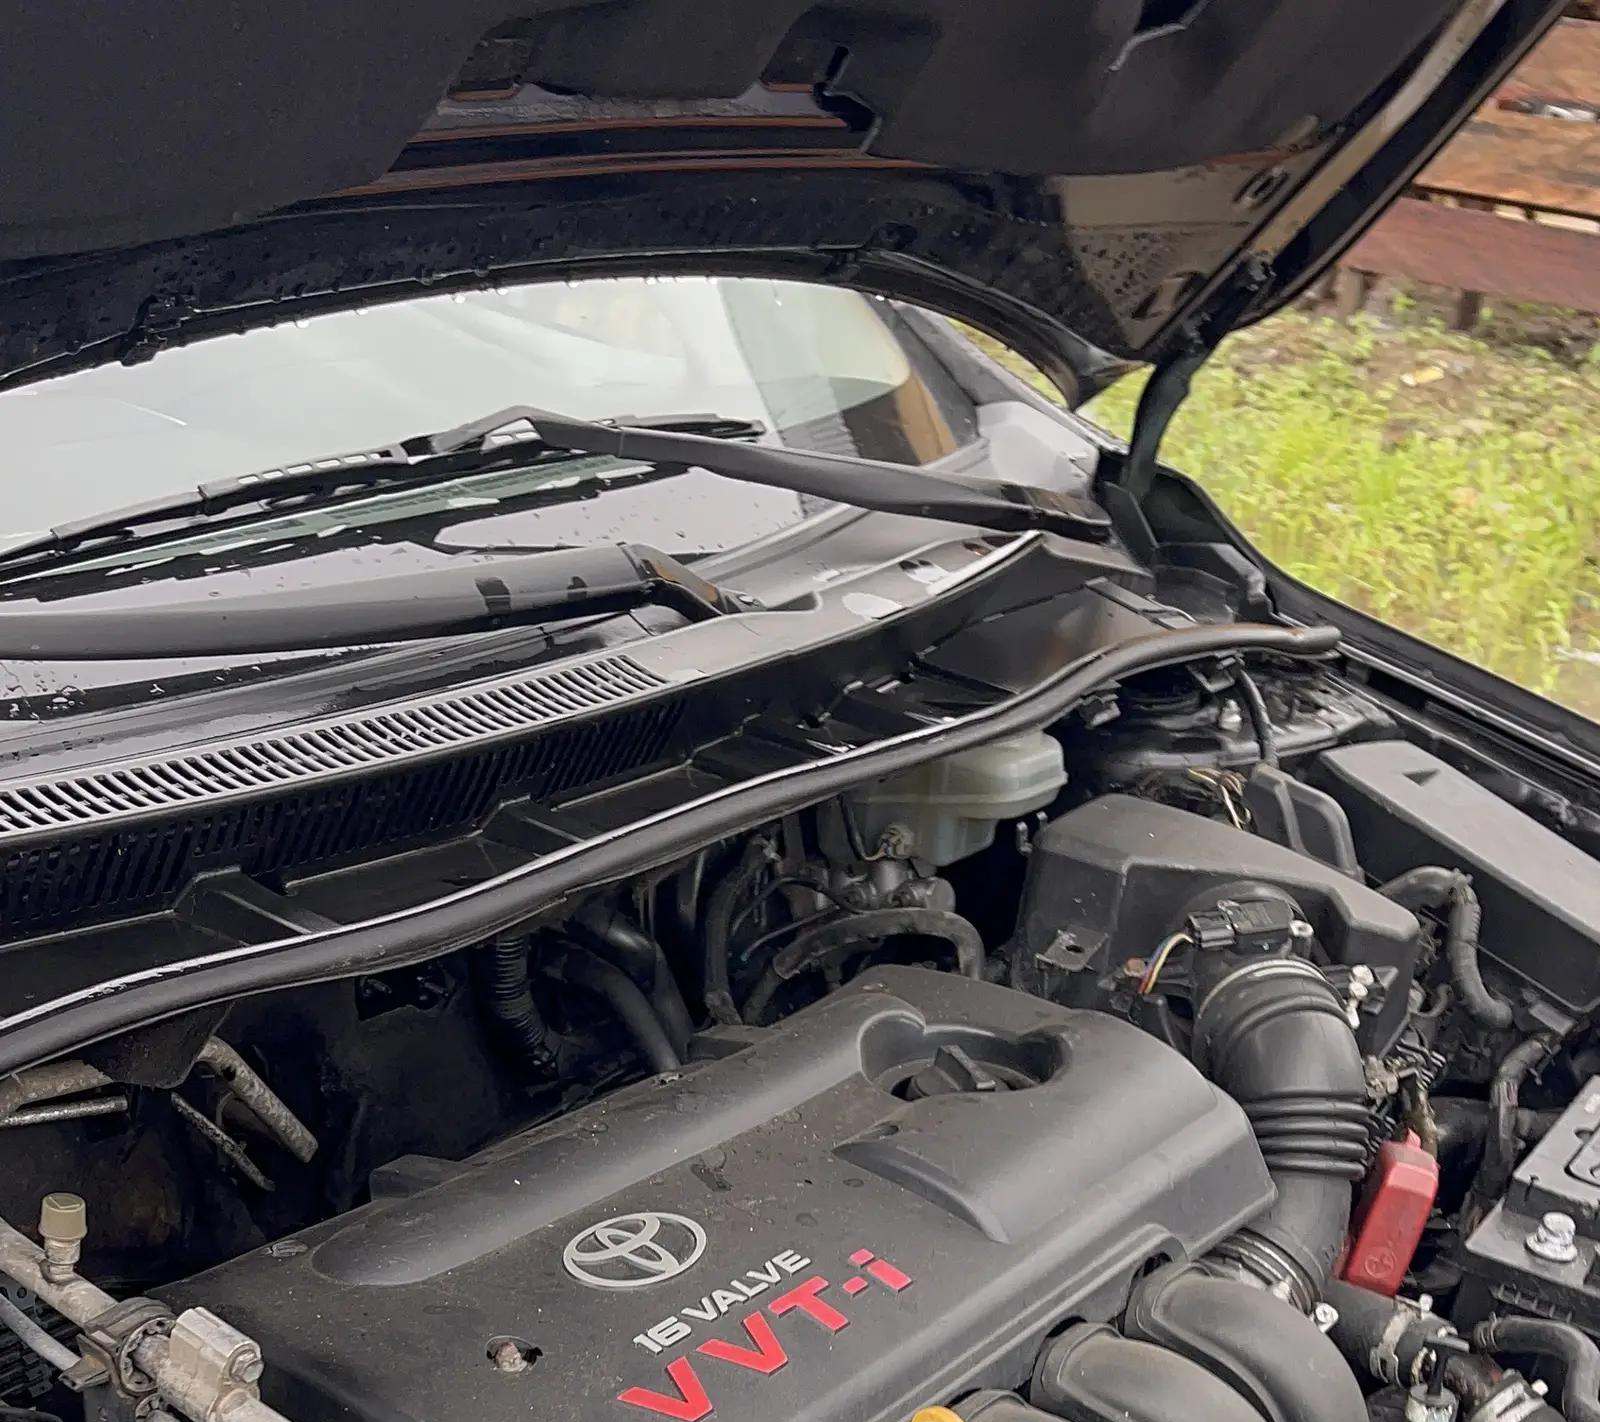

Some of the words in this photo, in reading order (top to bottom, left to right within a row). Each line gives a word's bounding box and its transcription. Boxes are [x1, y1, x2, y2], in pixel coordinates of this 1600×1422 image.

[617, 1248, 912, 1422] VVT-i
[633, 1316, 692, 1354] 16
[681, 1249, 811, 1322] VALVE
